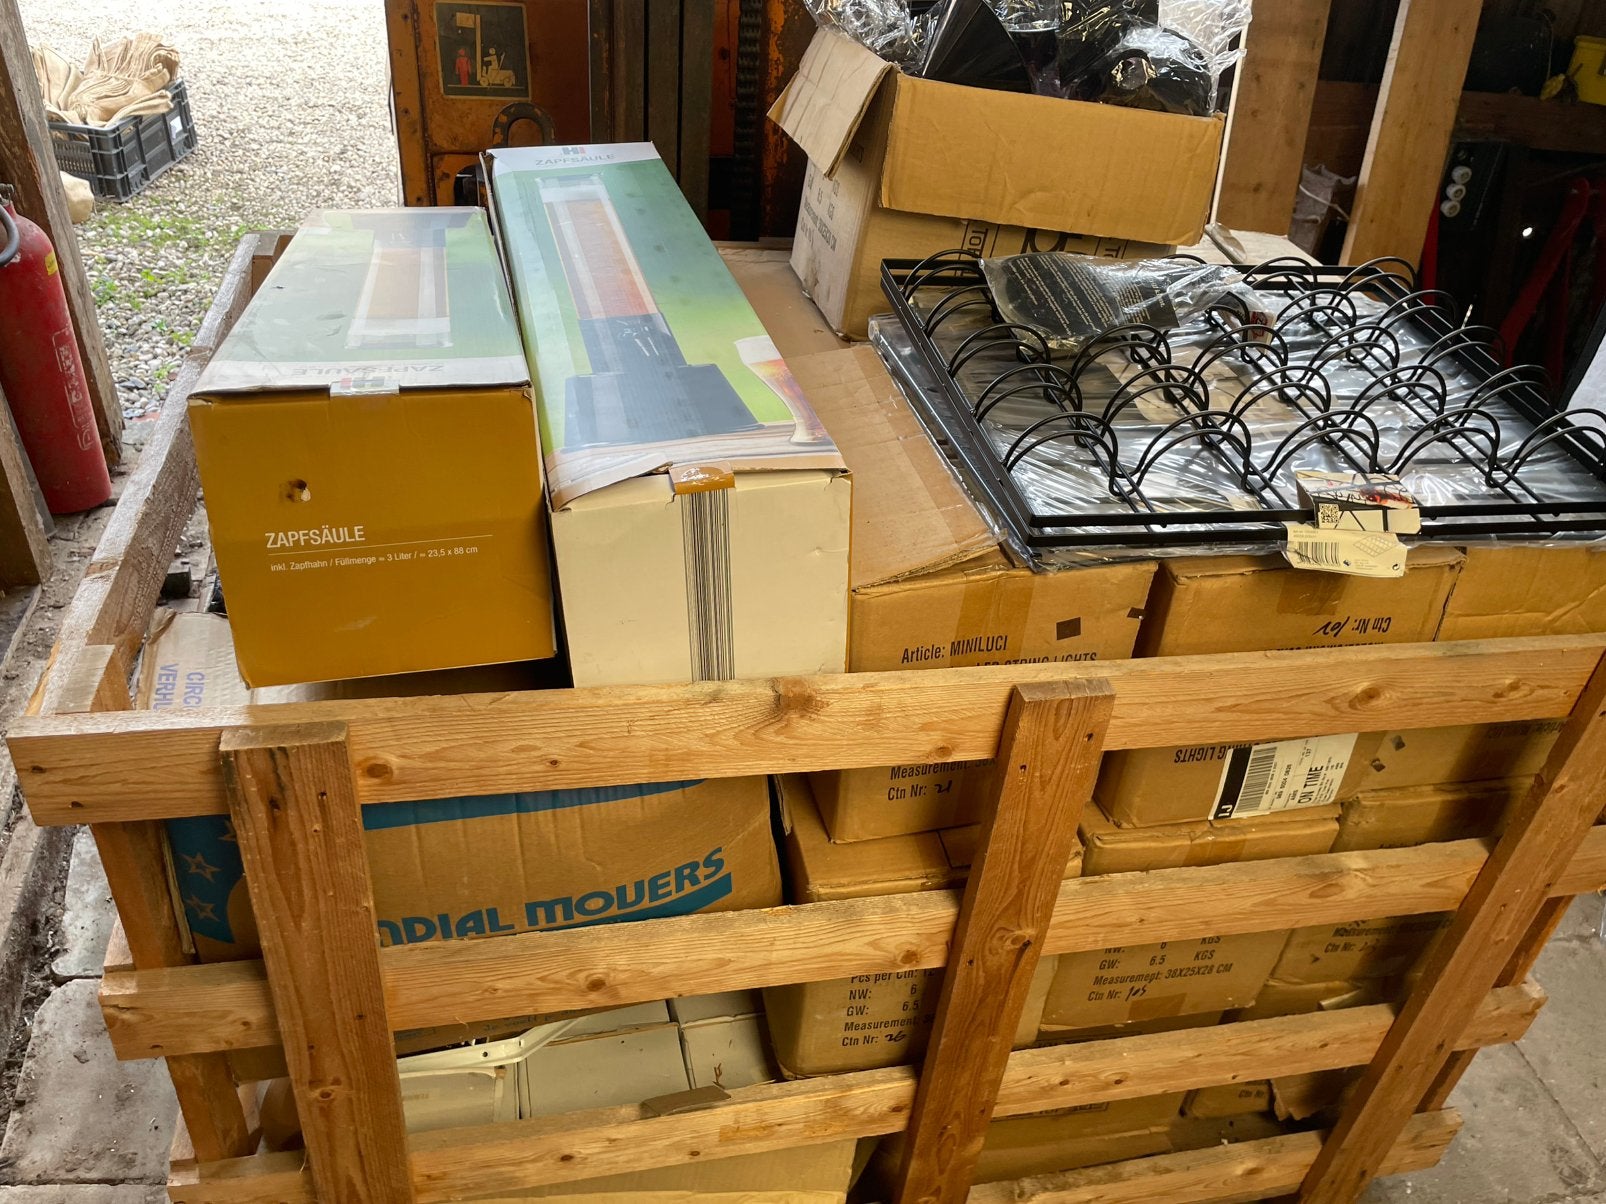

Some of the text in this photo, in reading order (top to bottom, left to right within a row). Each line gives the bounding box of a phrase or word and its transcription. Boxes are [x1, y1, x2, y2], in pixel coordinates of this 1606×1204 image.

[264, 525, 366, 549] ZAPFSÄULE
[271, 563, 289, 571] inkl.
[290, 559, 328, 570] Zapfhahn
[335, 555, 377, 566] Füllmenge
[386, 553, 393, 562] 3
[394, 551, 412, 561] Liter
[427, 548, 446, 558] 23,5
[453, 546, 464, 555] 88
[465, 546, 478, 554] cm
[1351, 616, 1392, 635] Ctn Nr:
[901, 635, 1009, 664] Article: MINILUCI
[183, 672, 206, 708] CIRC
[1174, 746, 1217, 763] LIGHTS
[1303, 765, 1324, 788] TIME
[887, 783, 928, 801] Ctn Nr:
[1297, 790, 1315, 804] ON
[1099, 949, 1216, 971] GW: 6.5 KGS
[874, 972, 892, 984] per
[1164, 966, 1214, 980] 38X25X28
[1216, 963, 1234, 974] CM
[849, 984, 918, 1000] NW: 6
[1087, 989, 1122, 1002] Ctn Nr:
[846, 1005, 869, 1017] GW:
[841, 1035, 879, 1047] Ctn Nr:
